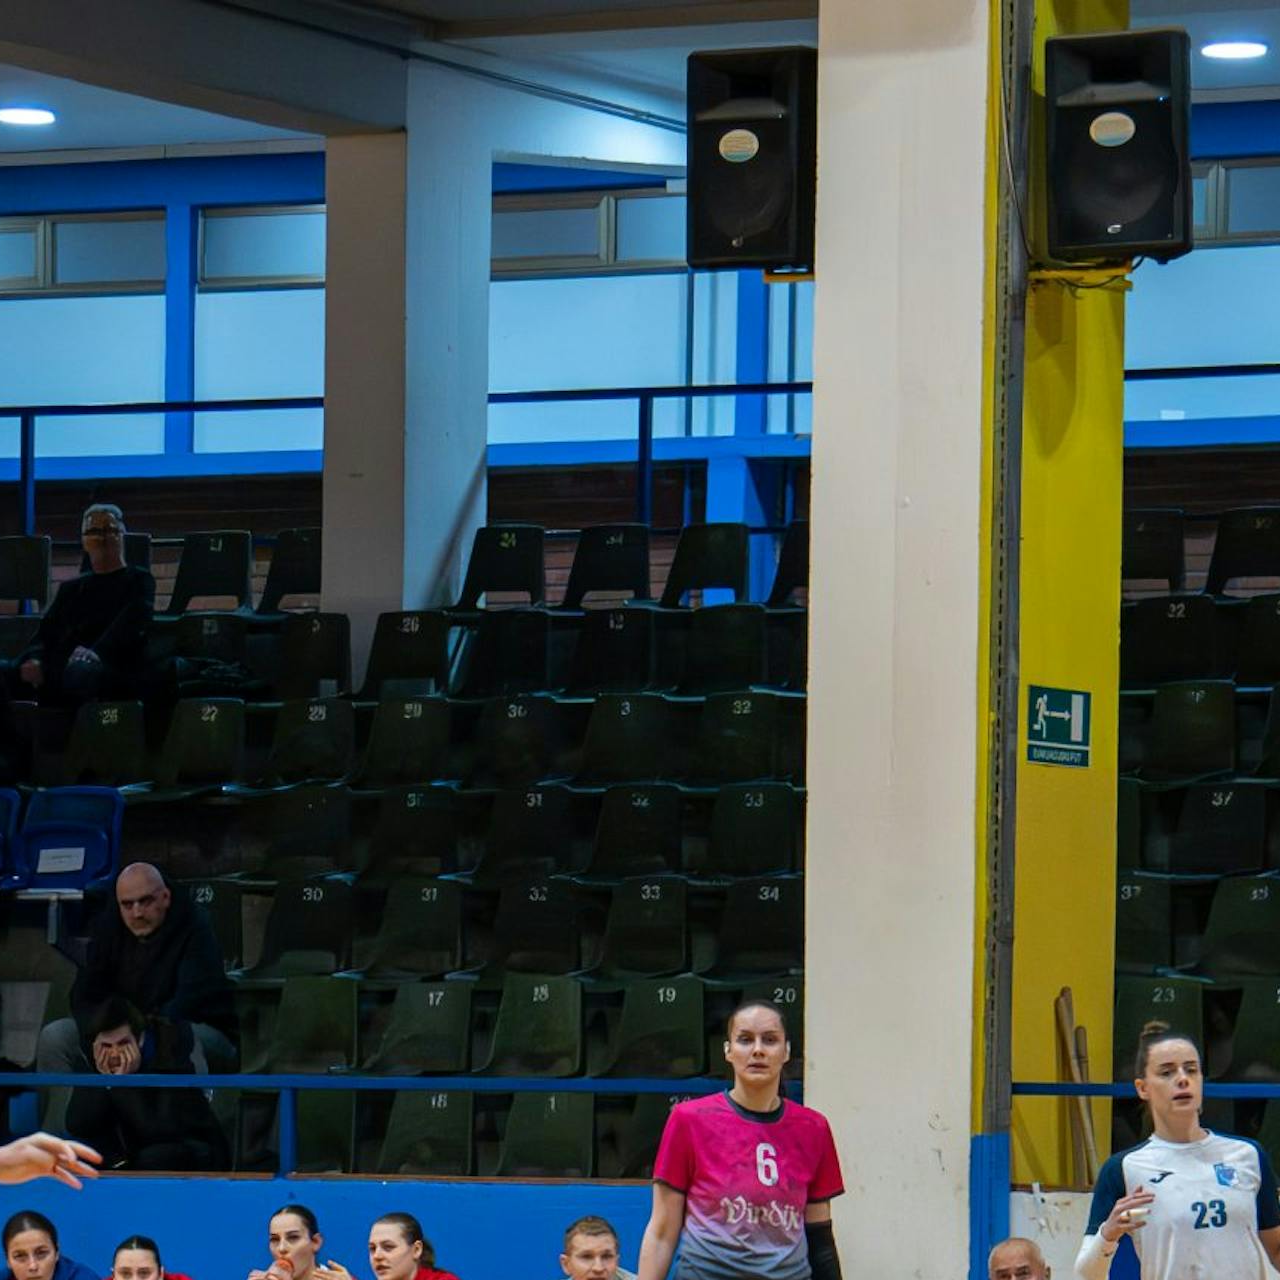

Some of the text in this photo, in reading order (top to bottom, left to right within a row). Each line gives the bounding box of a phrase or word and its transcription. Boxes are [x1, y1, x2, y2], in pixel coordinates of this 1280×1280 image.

[657, 988, 676, 1003] 19
[773, 988, 797, 1003] 20
[1152, 988, 1175, 1003] 23
[755, 1143, 778, 1186] 6
[1191, 1199, 1227, 1229] 23
